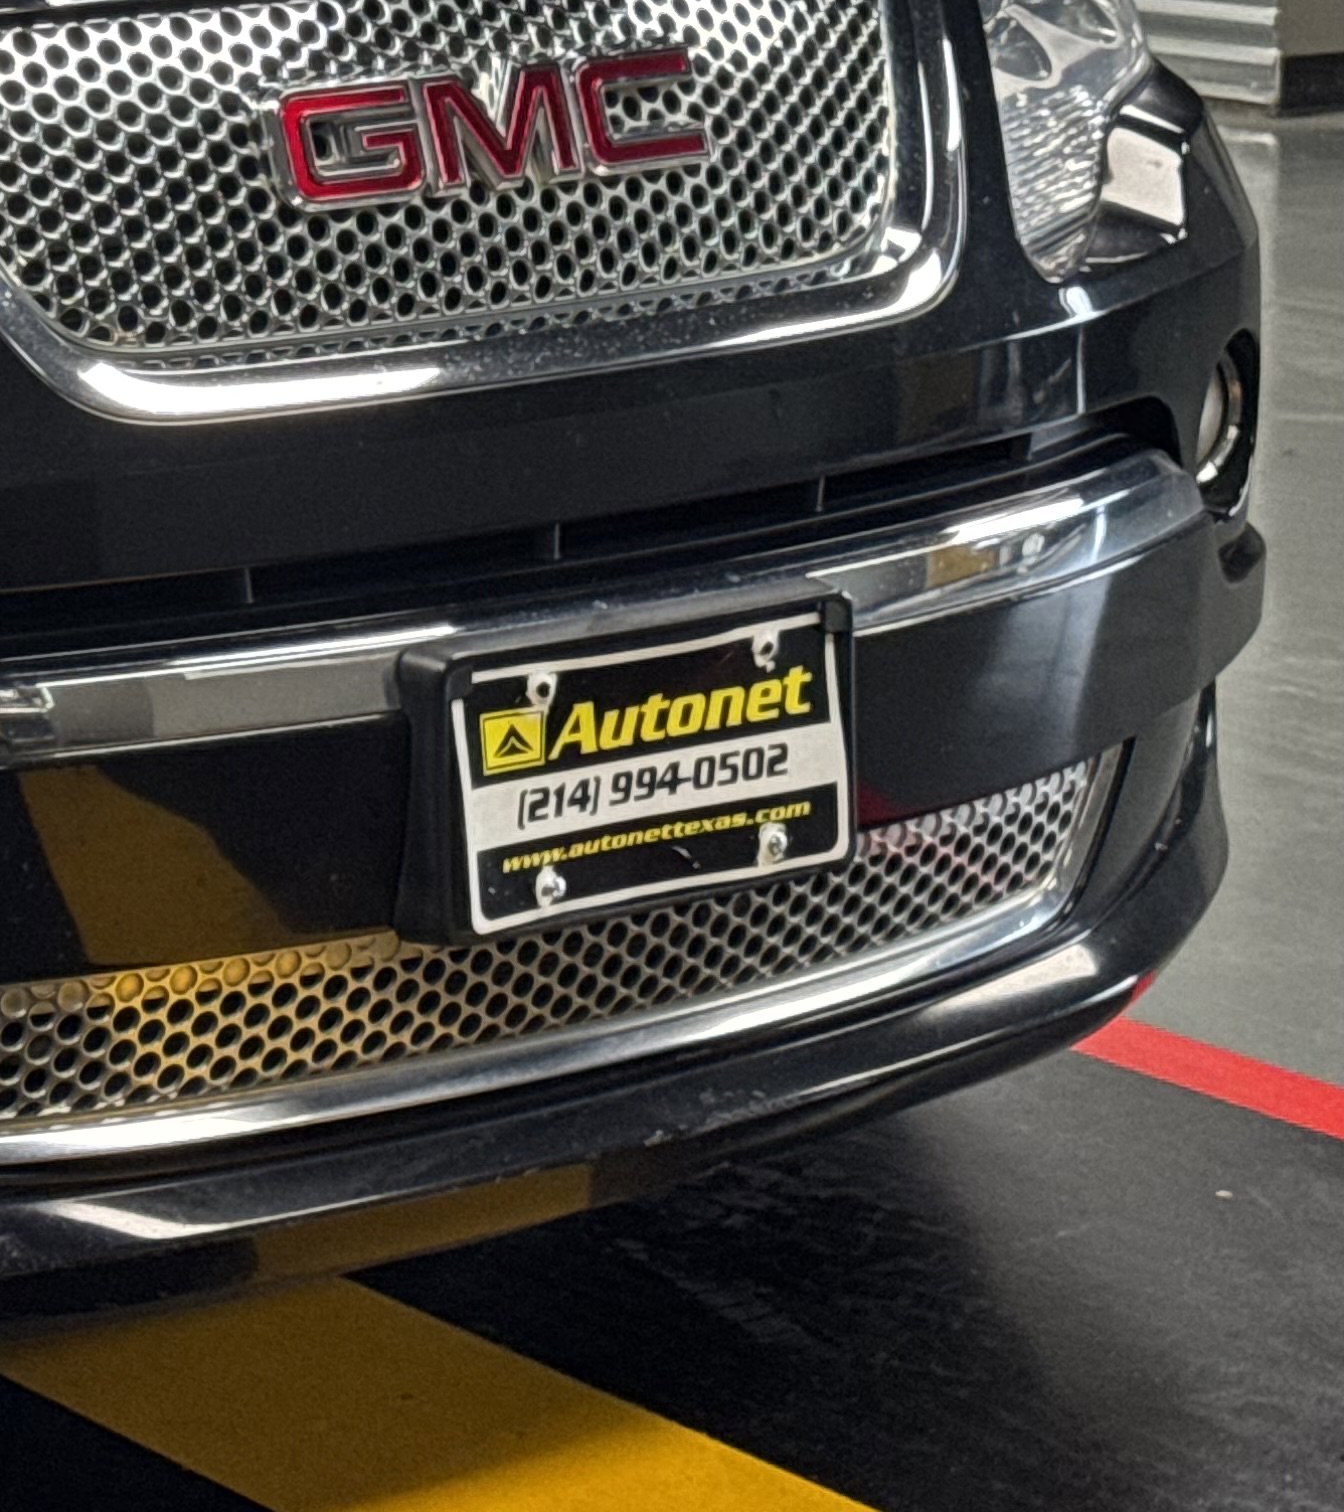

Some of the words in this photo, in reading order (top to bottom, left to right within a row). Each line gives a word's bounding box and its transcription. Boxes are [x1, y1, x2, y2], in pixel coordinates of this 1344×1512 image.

[277, 46, 711, 210] GMC
[550, 666, 812, 759] Autonet
[517, 776, 600, 830] (214)
[610, 744, 789, 806] 994-0502
[503, 801, 811, 873] www.autonettexas.com
